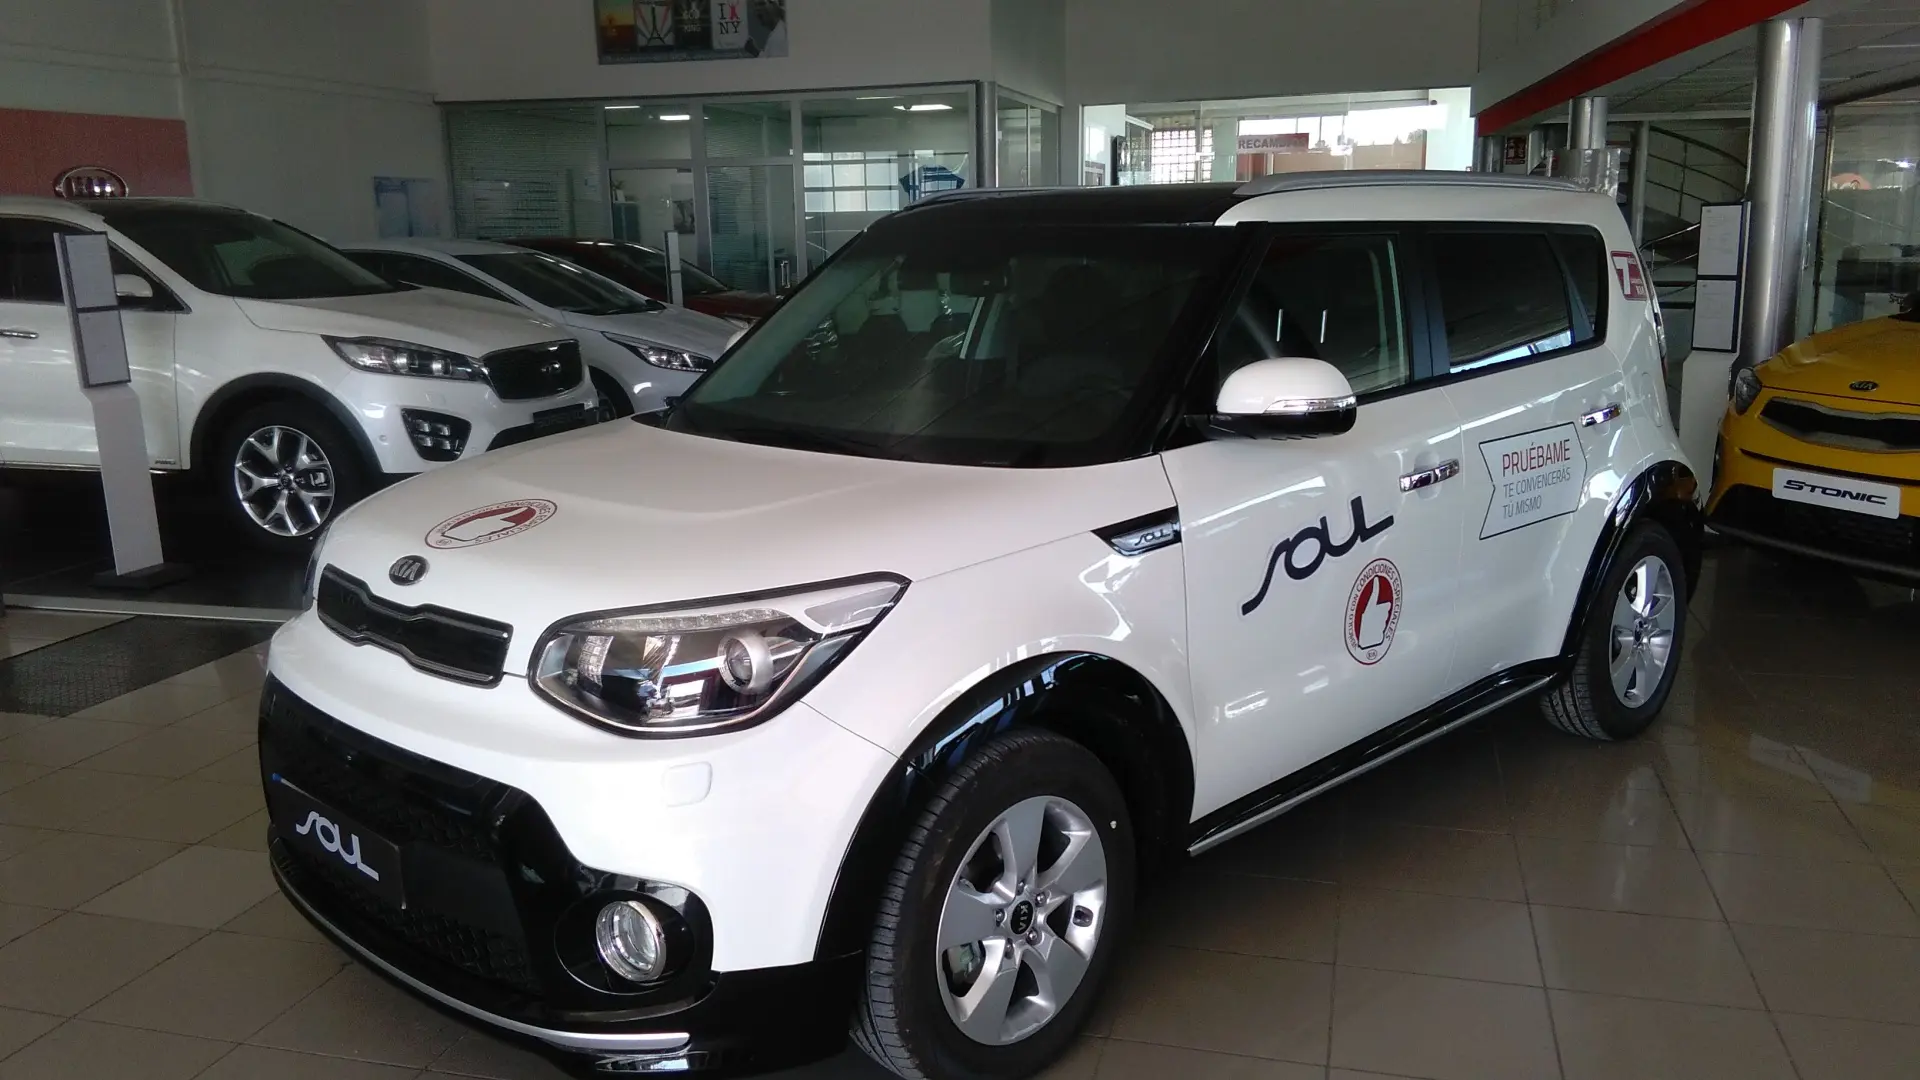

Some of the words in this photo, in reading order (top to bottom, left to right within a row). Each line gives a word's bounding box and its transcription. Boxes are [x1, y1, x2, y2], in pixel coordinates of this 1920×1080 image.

[717, 3, 726, 20] I
[719, 21, 741, 35] NY
[1852, 382, 1874, 390] KIA
[1502, 439, 1571, 478] PRUÉBAME
[1503, 482, 1515, 499] TE
[1515, 466, 1571, 495] CONVENCERÁS
[1783, 479, 1888, 505] STONIC
[1503, 500, 1514, 519] TÚ
[1515, 495, 1542, 516] MISMO
[1134, 529, 1171, 546] SOUL
[390, 558, 421, 581] KIA
[1241, 496, 1395, 617] SOUL
[1350, 594, 1359, 612] CON
[1356, 563, 1396, 593] CONDICIONES
[1386, 577, 1401, 641] ESPECIALES
[295, 810, 380, 882] SOUL
[1018, 904, 1029, 932] KIA
